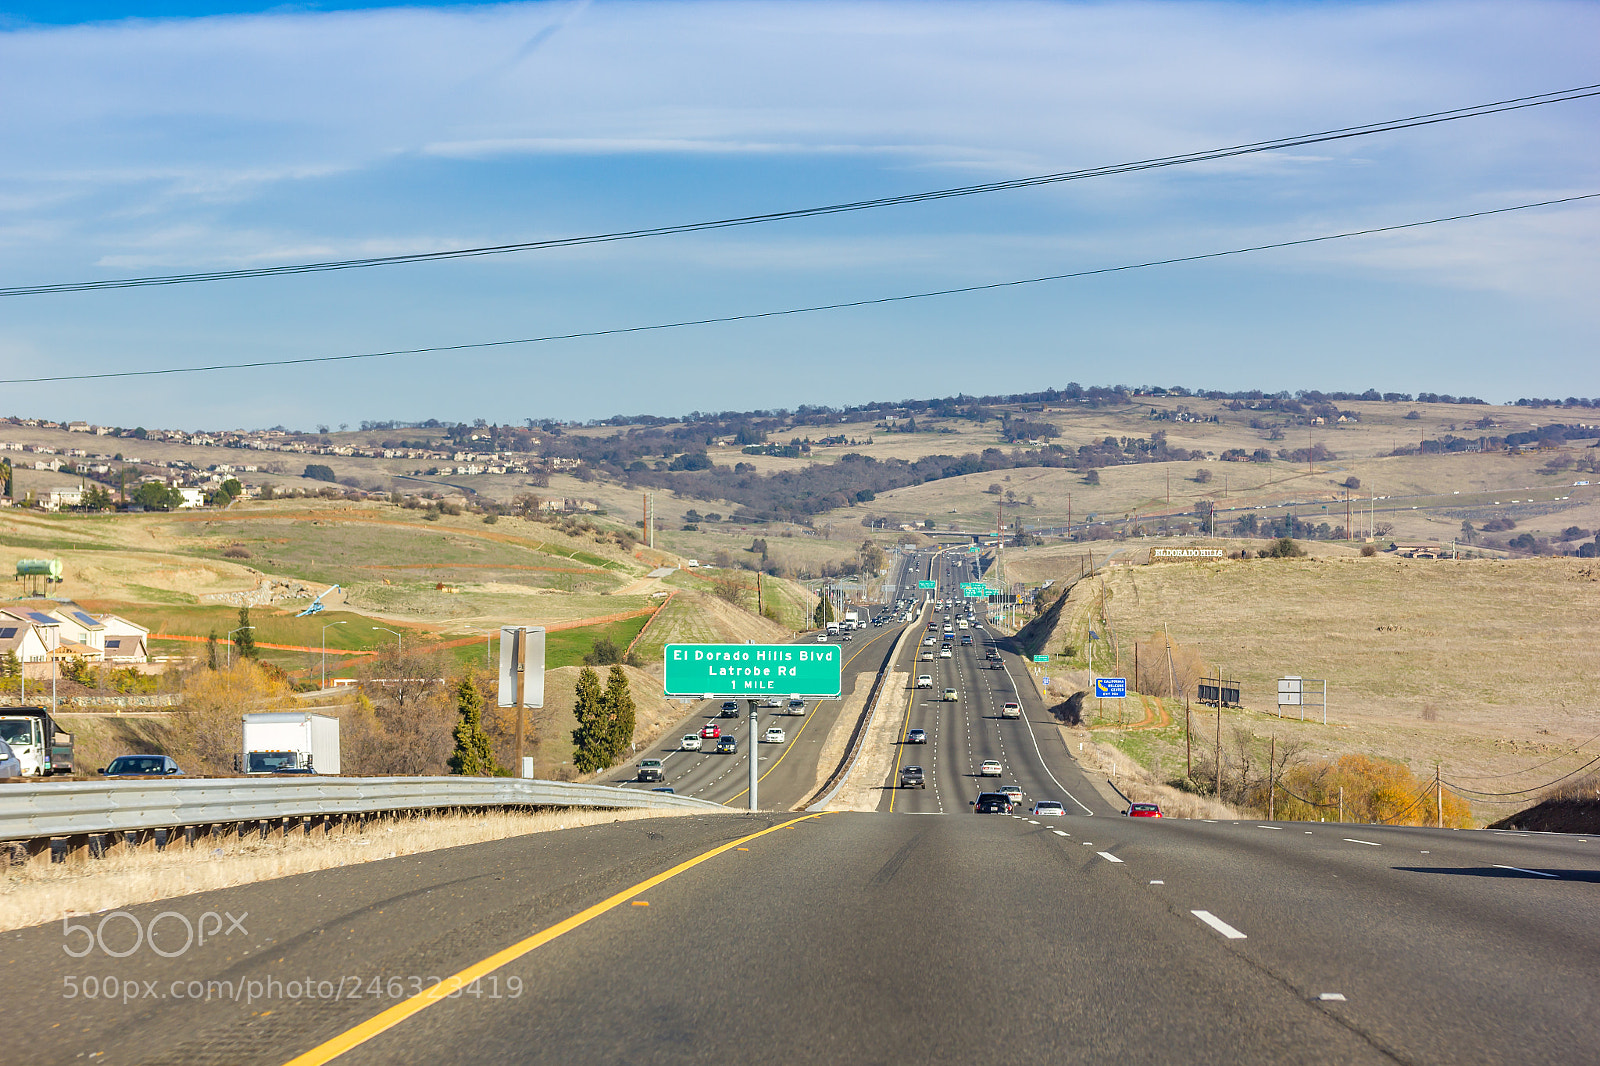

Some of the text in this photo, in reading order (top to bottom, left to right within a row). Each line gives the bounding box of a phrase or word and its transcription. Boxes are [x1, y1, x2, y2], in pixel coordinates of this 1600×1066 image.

[1200, 549, 1223, 557] HILLS
[673, 650, 833, 661] El Dorado Hills Blvd
[709, 666, 797, 676] Latrobe Rd
[731, 680, 774, 690] 1 MILE
